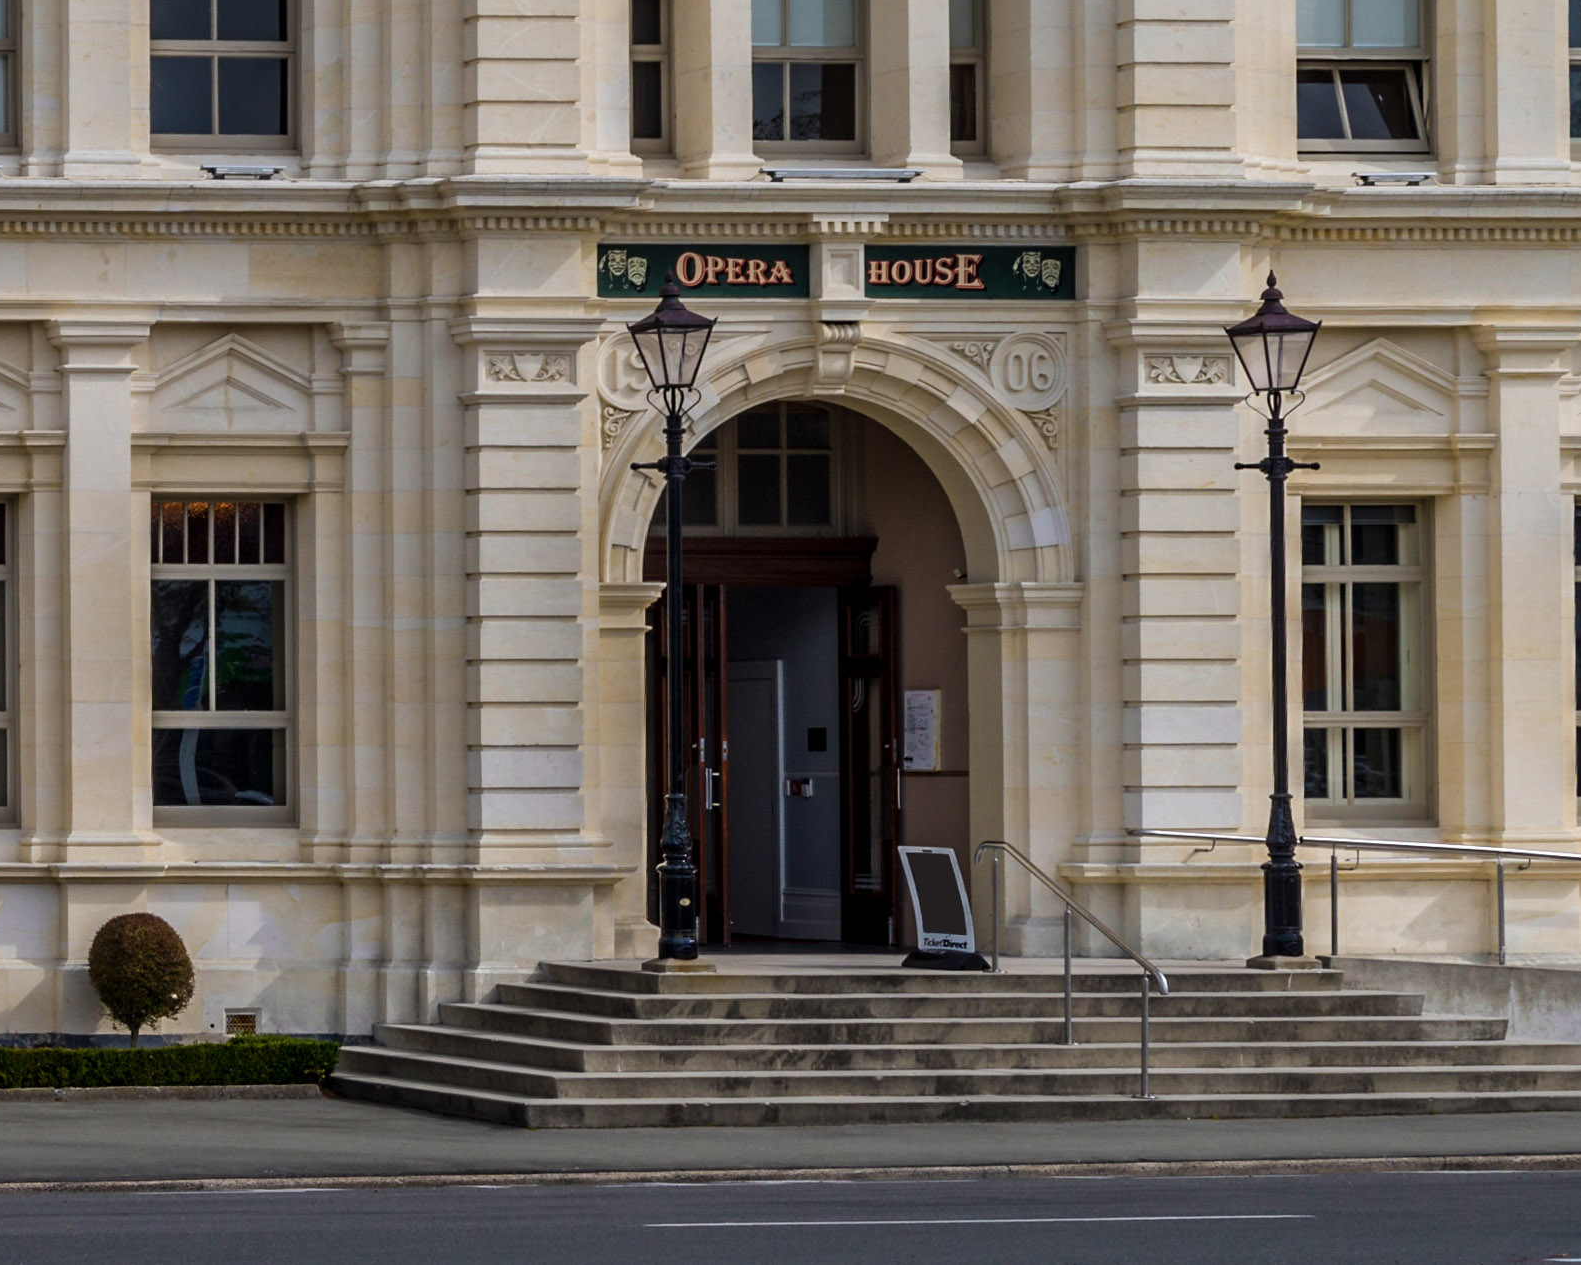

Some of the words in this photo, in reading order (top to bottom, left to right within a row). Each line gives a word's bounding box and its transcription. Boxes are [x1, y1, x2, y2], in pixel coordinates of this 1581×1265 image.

[676, 252, 794, 286] OPERA
[868, 254, 984, 289] HOUSE
[1006, 349, 1052, 392] 06
[923, 937, 967, 949] TicketDirect
